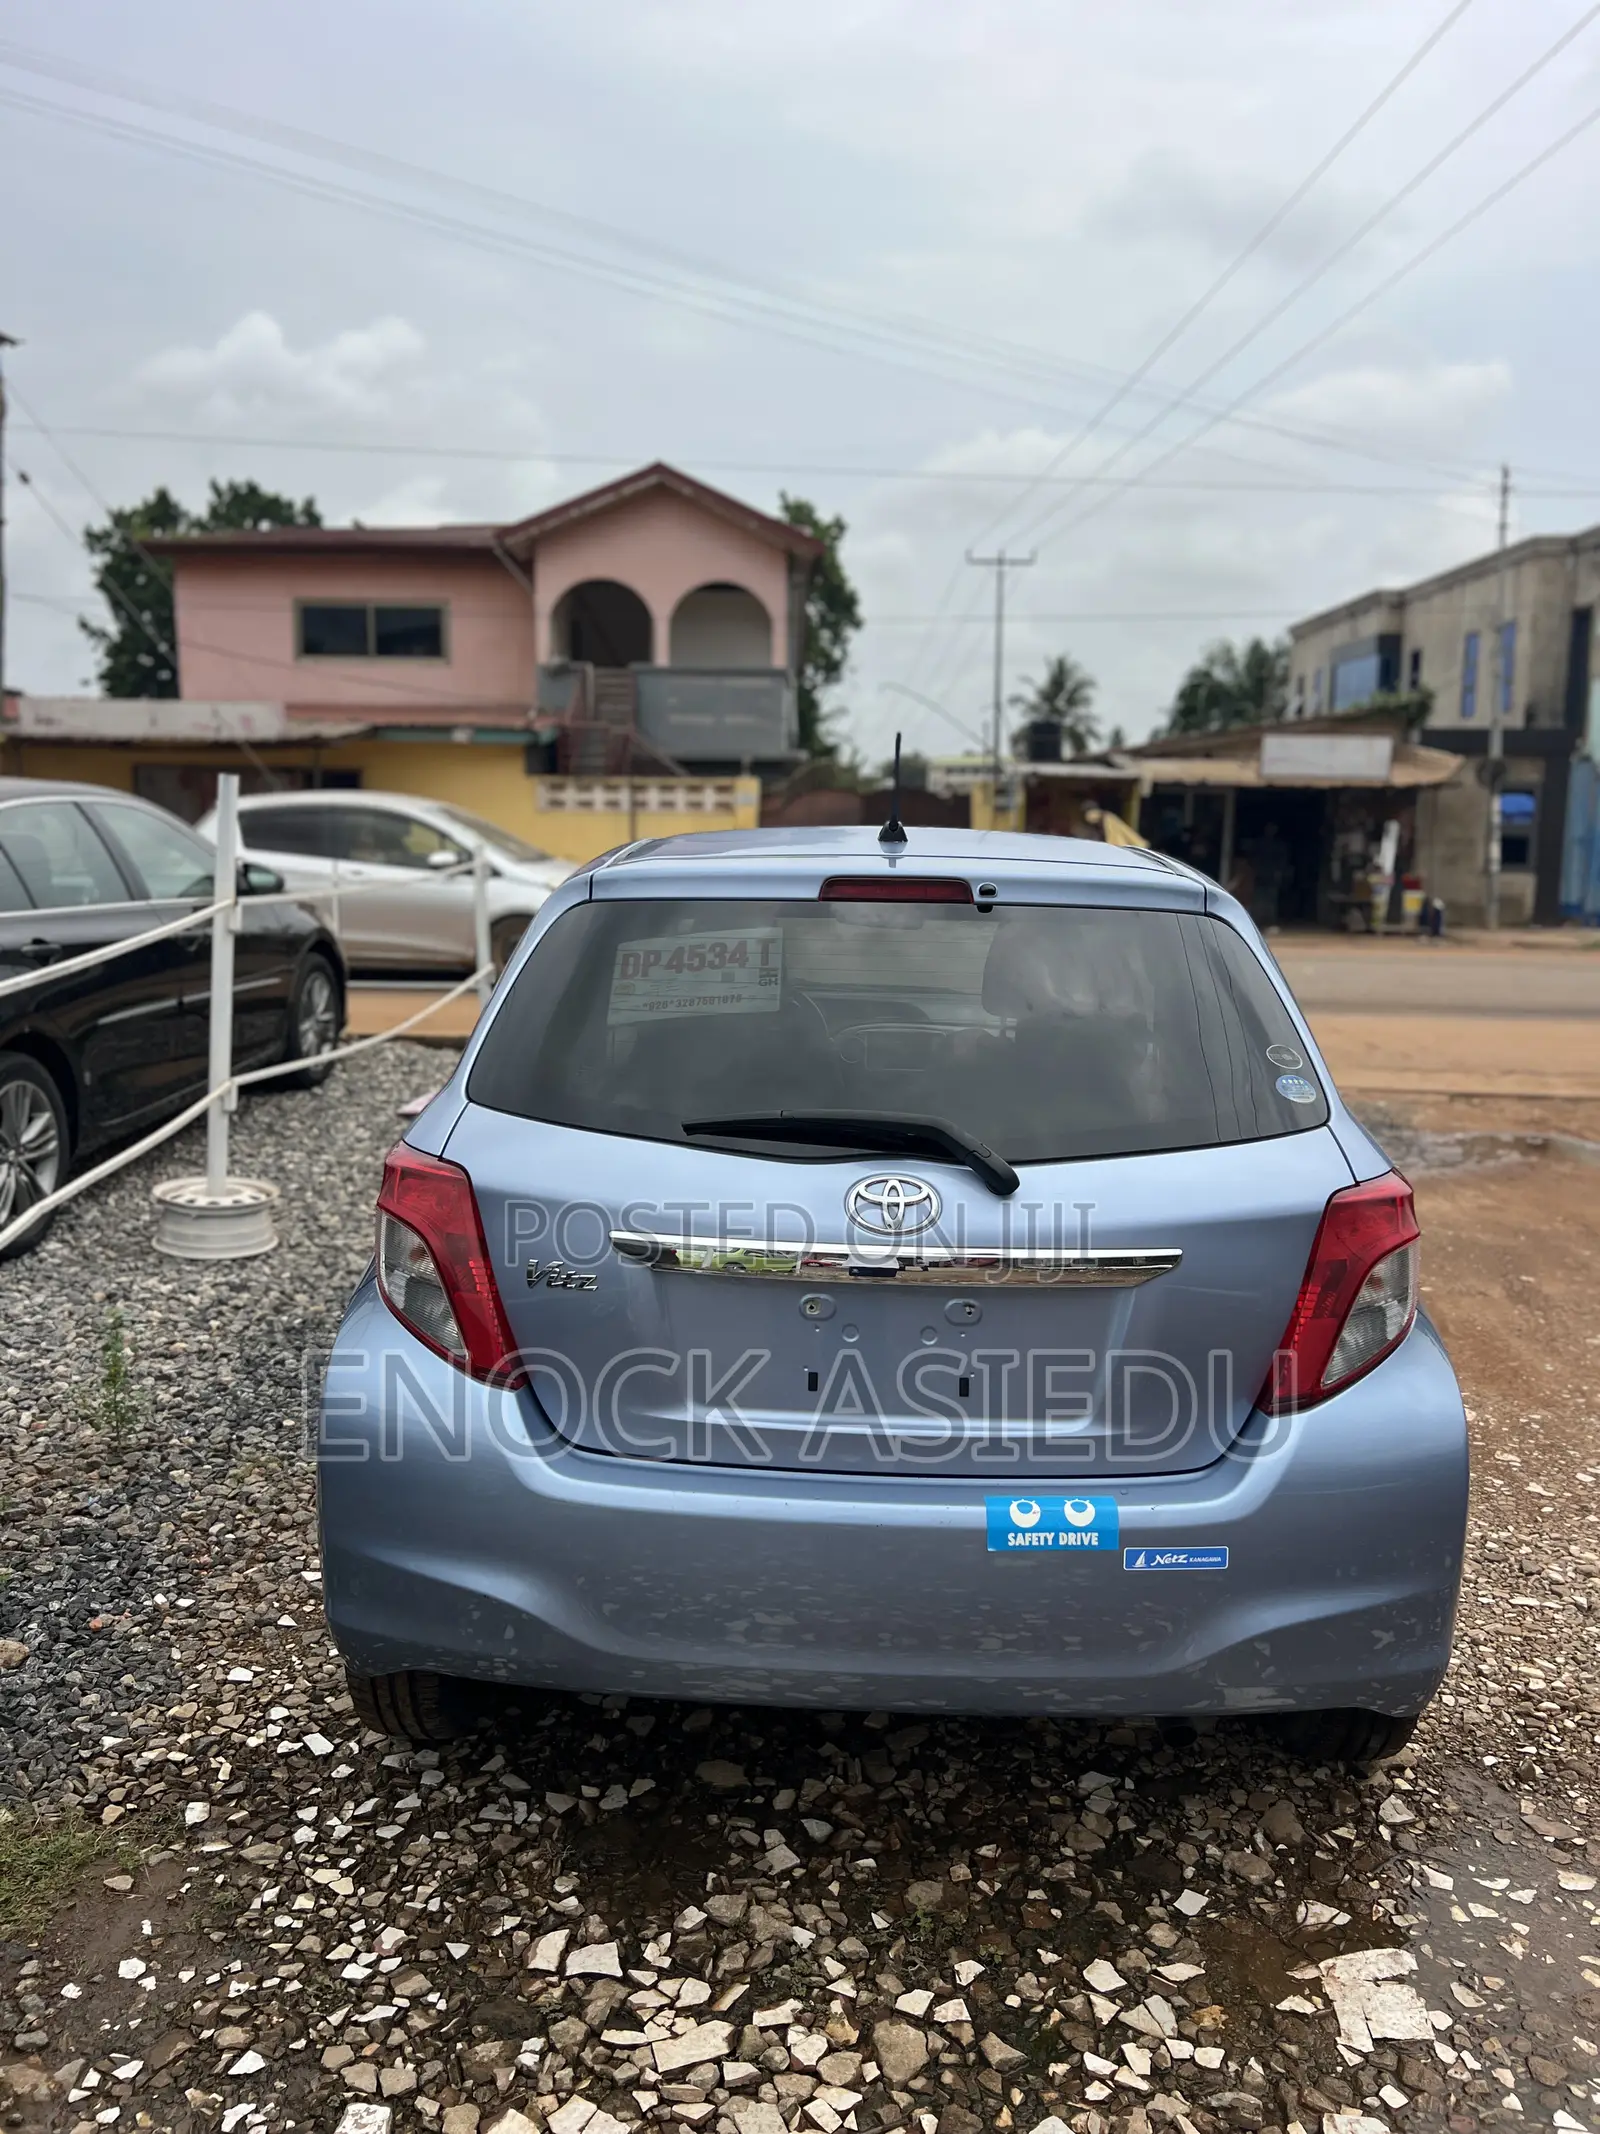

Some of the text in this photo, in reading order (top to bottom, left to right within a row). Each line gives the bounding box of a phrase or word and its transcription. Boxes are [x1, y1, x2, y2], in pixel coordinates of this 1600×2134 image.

[621, 951, 661, 980] DP
[664, 940, 748, 974] 4534
[758, 977, 778, 987] GH
[527, 1258, 599, 1291] Vitz
[1007, 1532, 1099, 1546] SAFETY DRIVE
[1150, 1553, 1188, 1566] Netz
